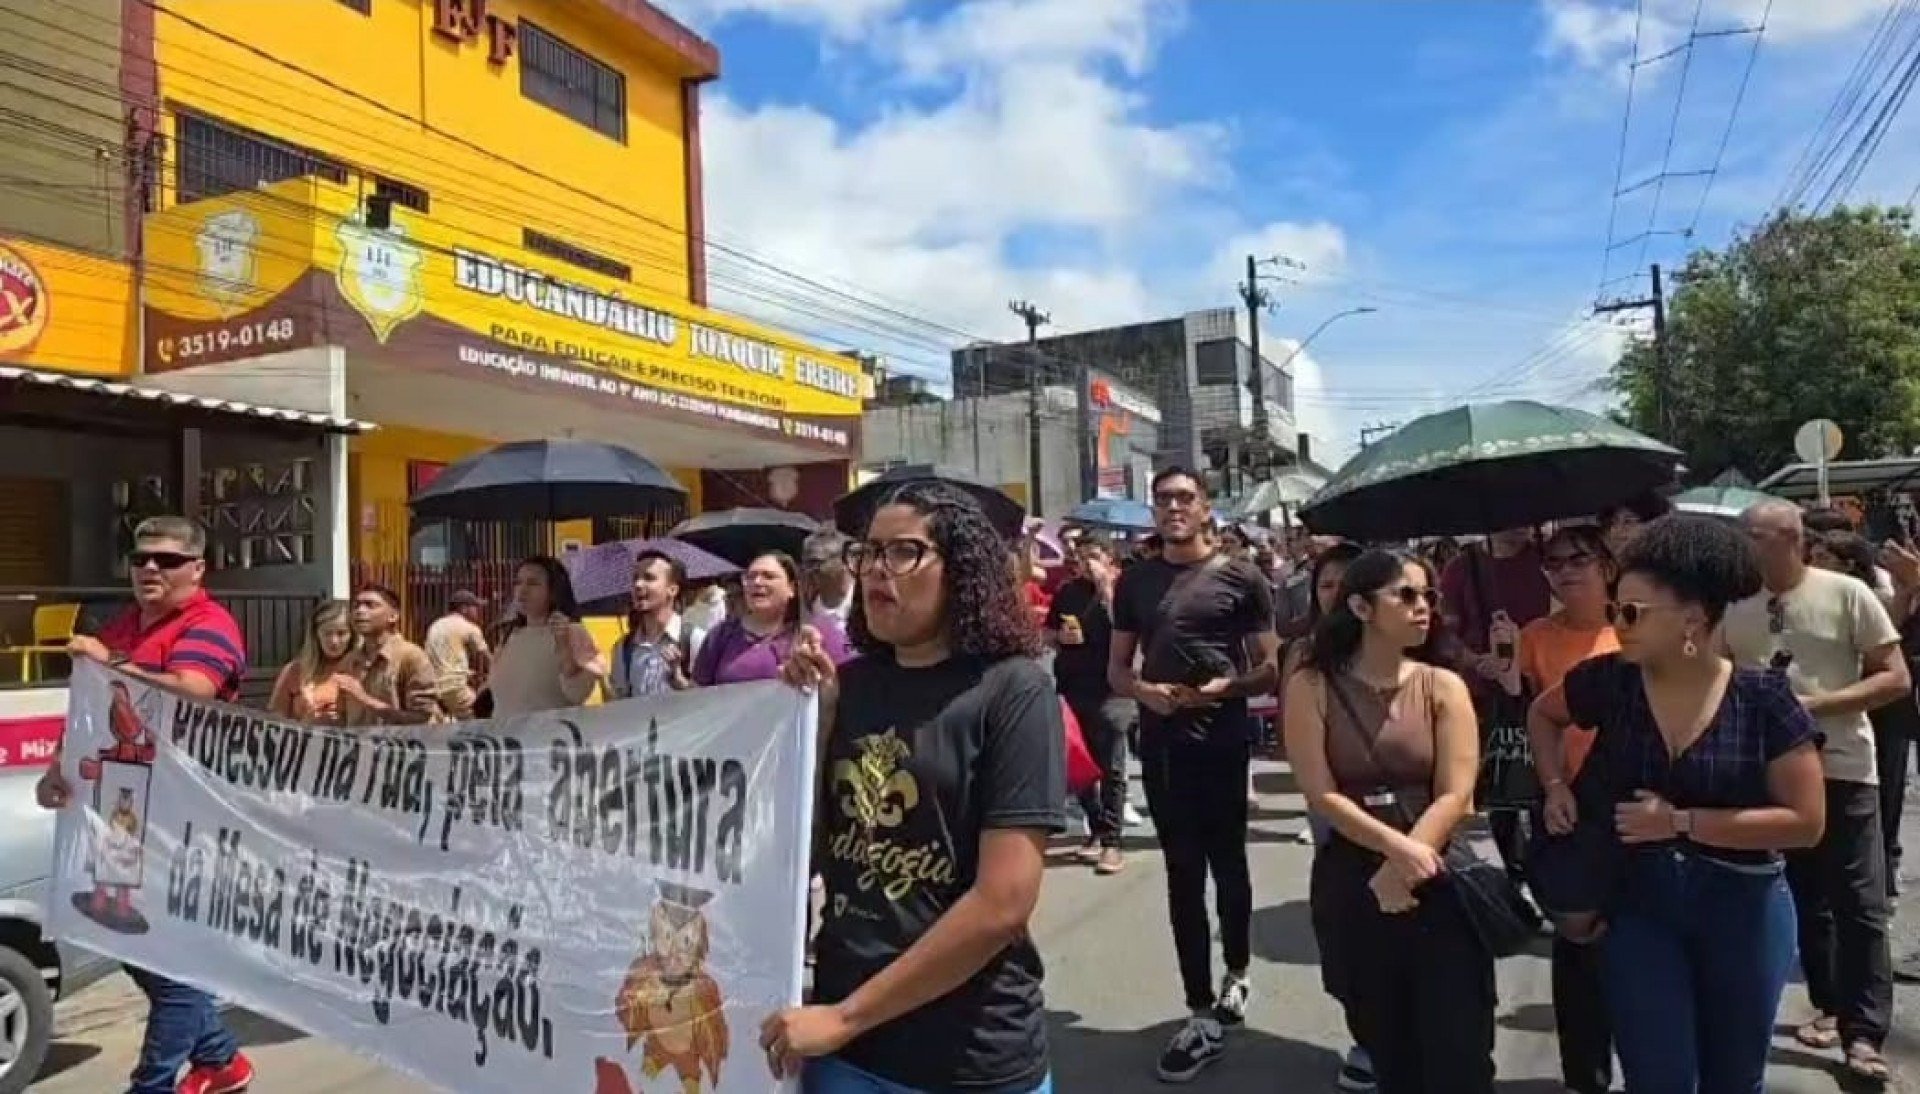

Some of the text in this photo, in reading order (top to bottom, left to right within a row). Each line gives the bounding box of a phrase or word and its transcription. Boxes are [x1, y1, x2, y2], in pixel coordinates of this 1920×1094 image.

[178, 317, 294, 358] 3519-0148
[453, 246, 677, 345] EDUCANDÁRIO
[688, 321, 784, 380] JOAQUIM
[490, 322, 548, 350] PARA
[553, 340, 631, 371] EDUCAR
[651, 363, 716, 392] PRECISO
[459, 345, 537, 376] EDUCAÇÃO
[540, 363, 598, 391] INFANTIL
[312, 730, 360, 801] na
[440, 732, 523, 851] pela
[547, 716, 747, 885] abertura
[167, 821, 204, 923] da
[206, 827, 285, 949] Mesa
[290, 849, 330, 965] de
